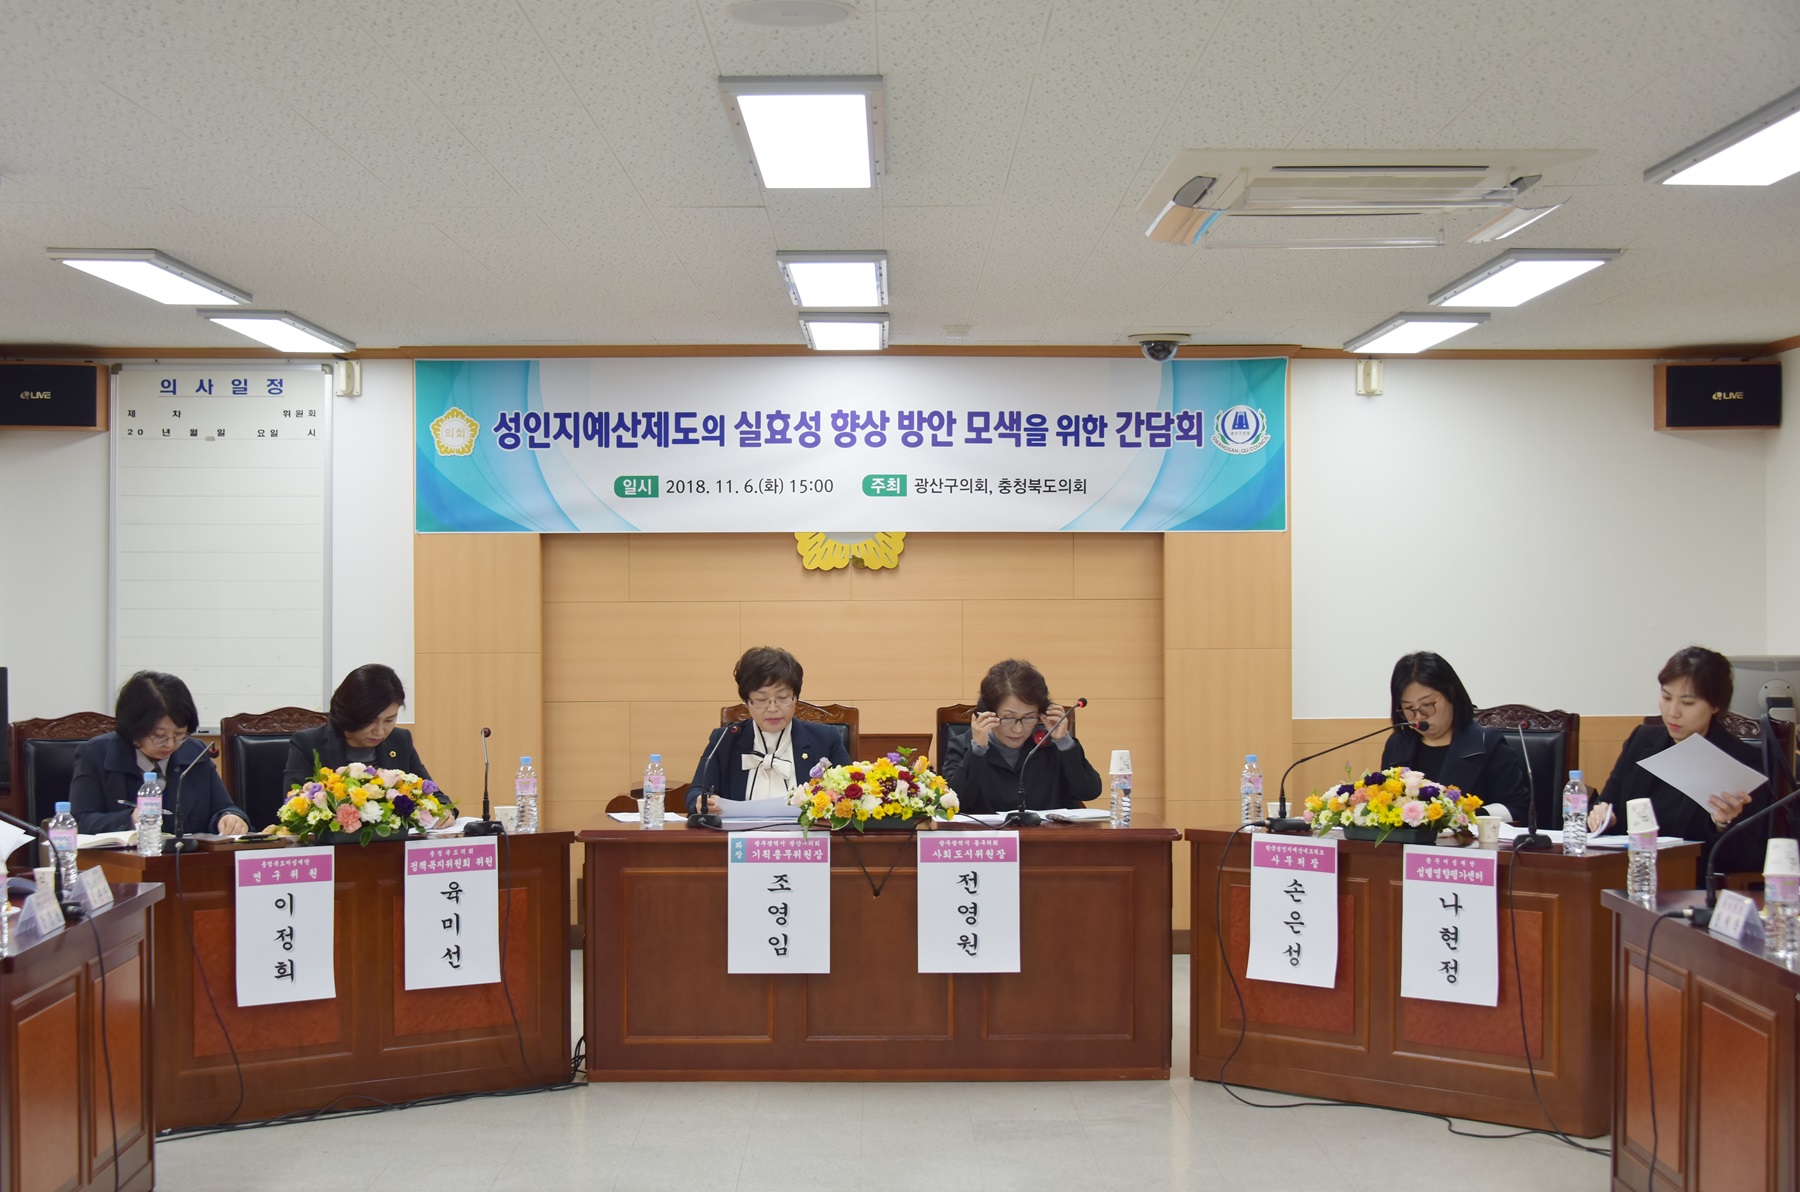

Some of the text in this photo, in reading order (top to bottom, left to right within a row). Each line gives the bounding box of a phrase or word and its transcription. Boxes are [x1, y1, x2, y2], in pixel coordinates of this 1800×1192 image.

[160, 378, 284, 395] 의사일정
[128, 410, 316, 418] 제 차 위원회
[162, 429, 170, 437] 년
[190, 429, 198, 437] 월
[217, 429, 225, 437] 일
[257, 429, 278, 437] 요일
[308, 429, 316, 437] 시
[444, 427, 467, 441] 의회
[493, 409, 1204, 449] 성인지예산제도의 실효성 향상 방안 모색을 위한 간담회
[622, 479, 652, 495] 일시
[666, 477, 834, 495] 2018. 11. 6.(화) 15:00
[870, 478, 901, 494] 주최
[914, 477, 1087, 496] 광산구의회, 충청북도의회
[476, 855, 493, 868] 위원
[752, 849, 823, 860] 기획총무위원장
[932, 848, 1006, 860] 사회도시위원장
[1271, 854, 1319, 869] 사무처장
[253, 867, 318, 883] 연구위원
[767, 873, 792, 957] 조영임
[956, 870, 979, 957] 전영원
[440, 880, 464, 969] 육미선
[1283, 878, 1306, 967] 손은성
[274, 892, 296, 984] 이정희
[1438, 892, 1464, 984] 나현정
